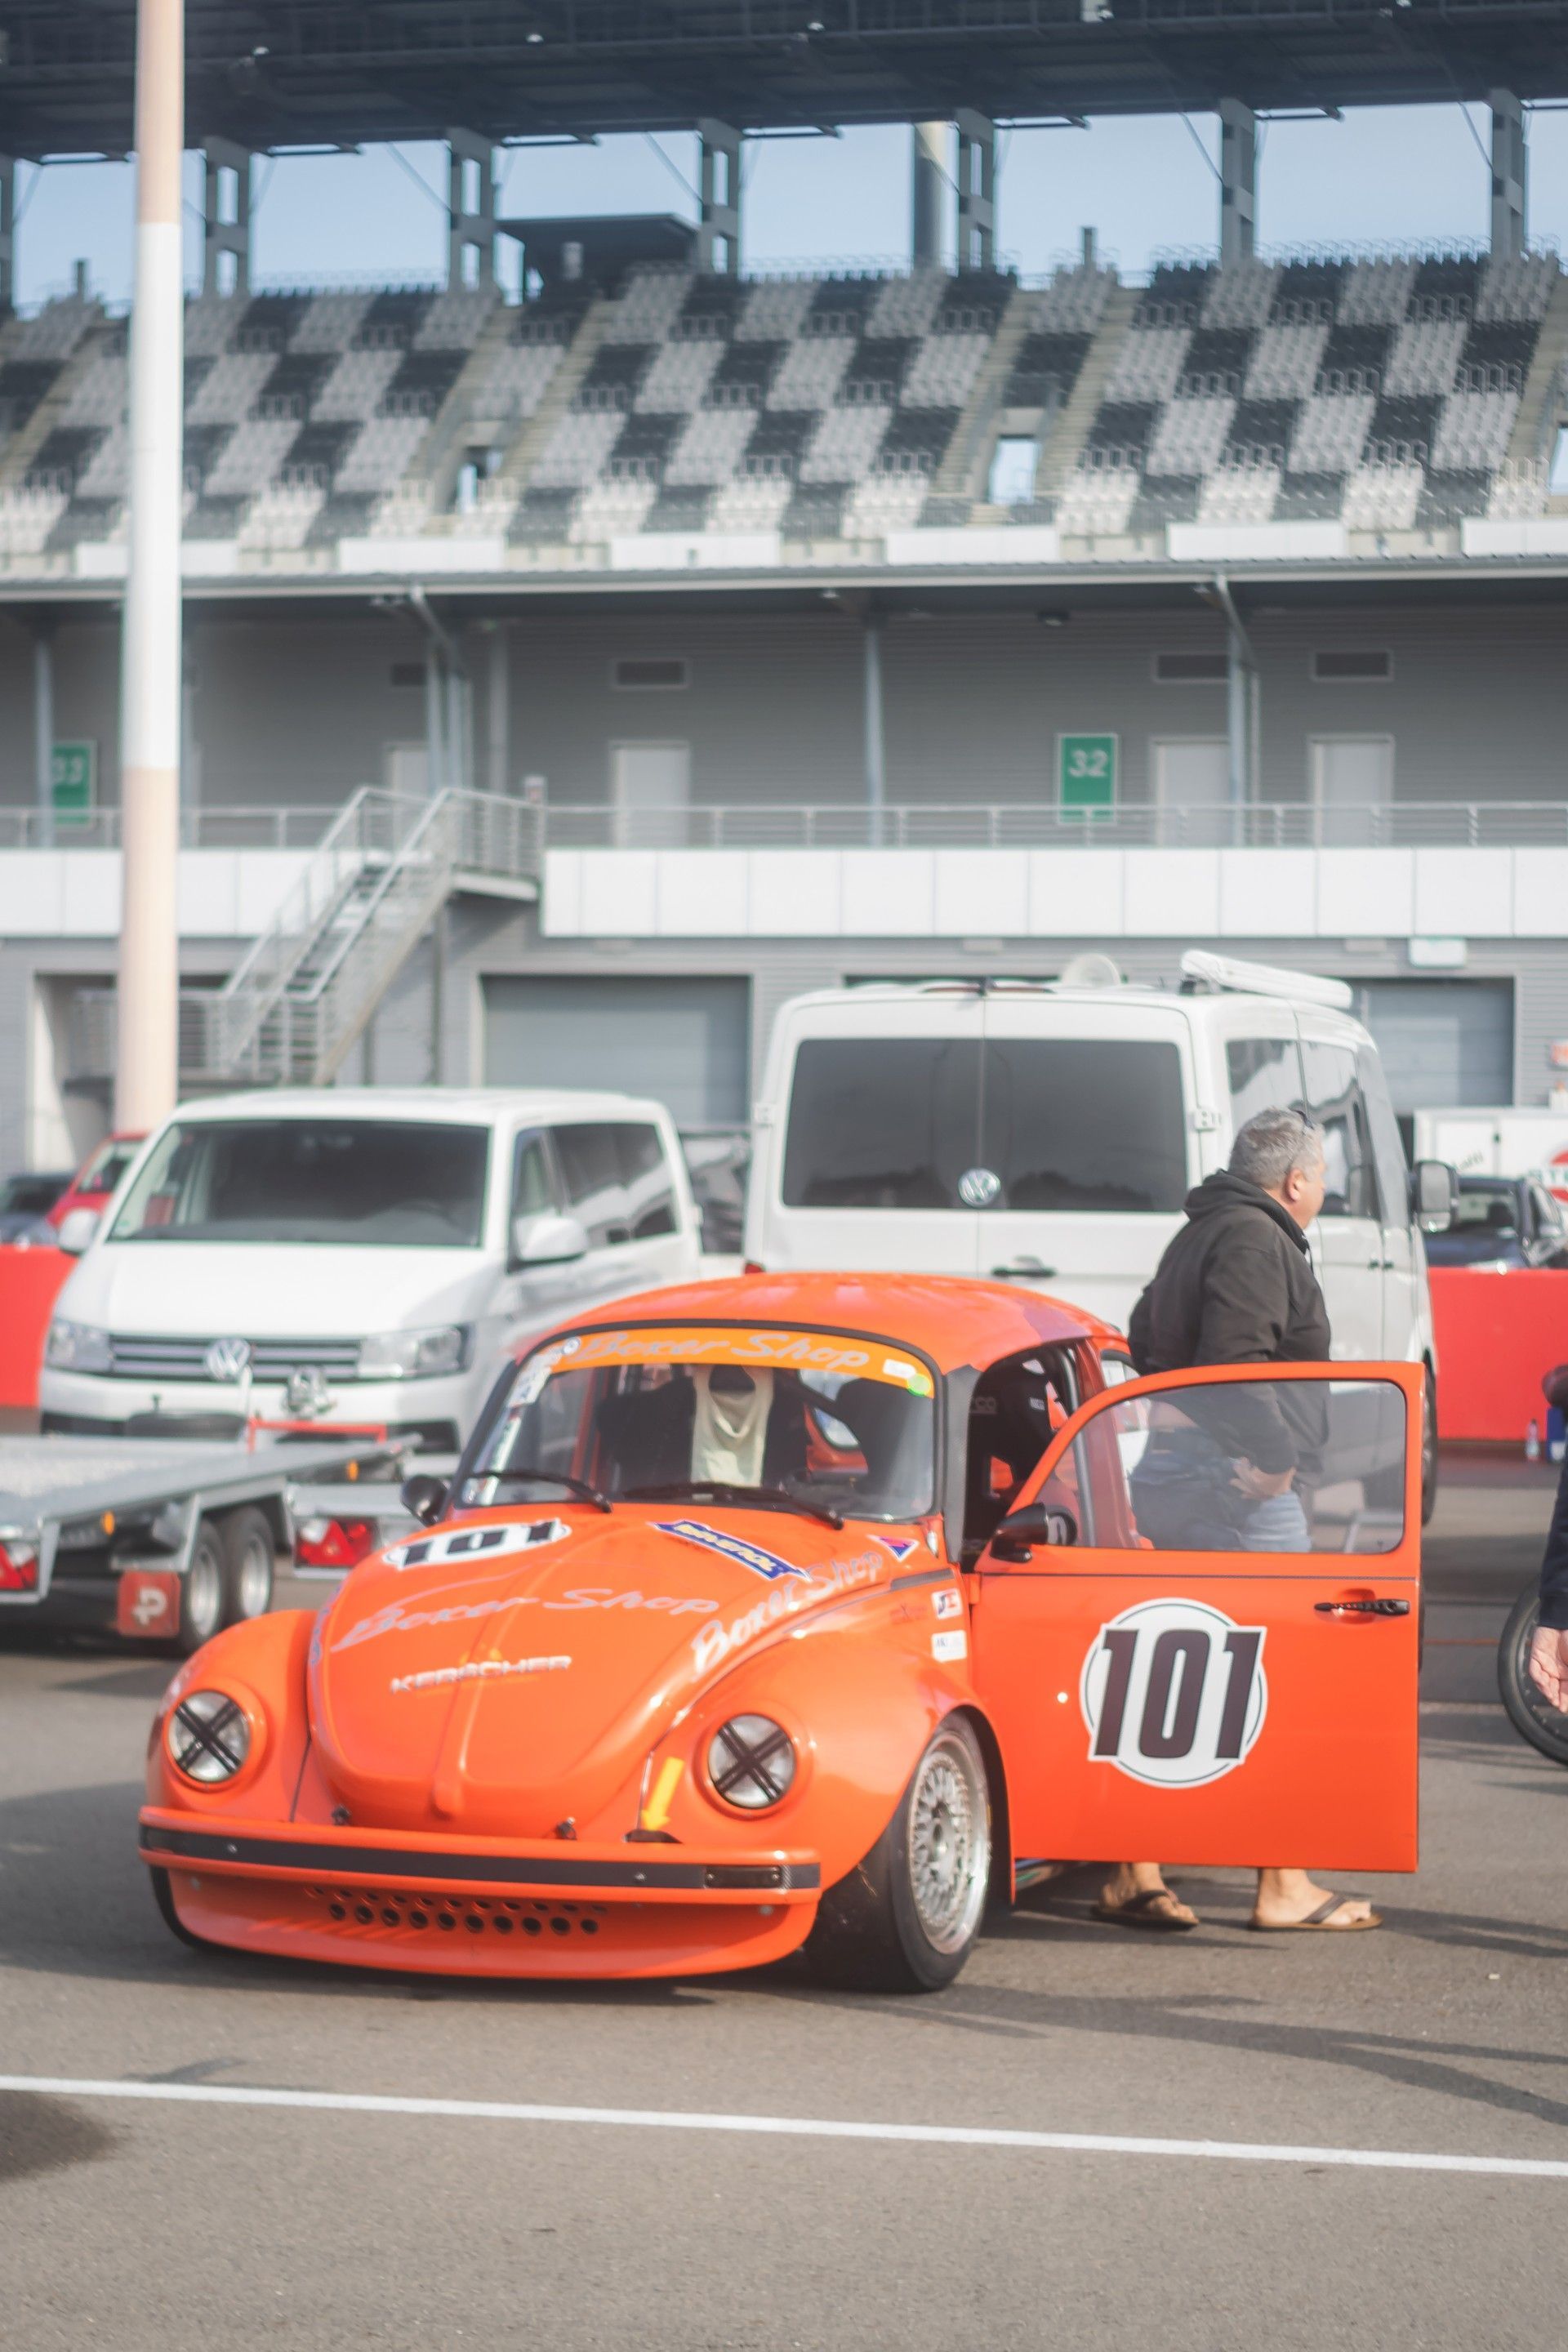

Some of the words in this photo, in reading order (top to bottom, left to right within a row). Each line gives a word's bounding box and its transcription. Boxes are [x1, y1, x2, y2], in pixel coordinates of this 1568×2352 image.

[1068, 749, 1108, 777] 32
[566, 1330, 724, 1364] Boxer
[730, 1333, 871, 1369] Shop
[400, 1519, 561, 1568] 101
[330, 1597, 540, 1653] Boxer
[542, 1588, 720, 1615] Shop
[691, 1579, 798, 1678] Boxer
[802, 1550, 884, 1598] Shop
[1094, 1628, 1263, 1760] 101
